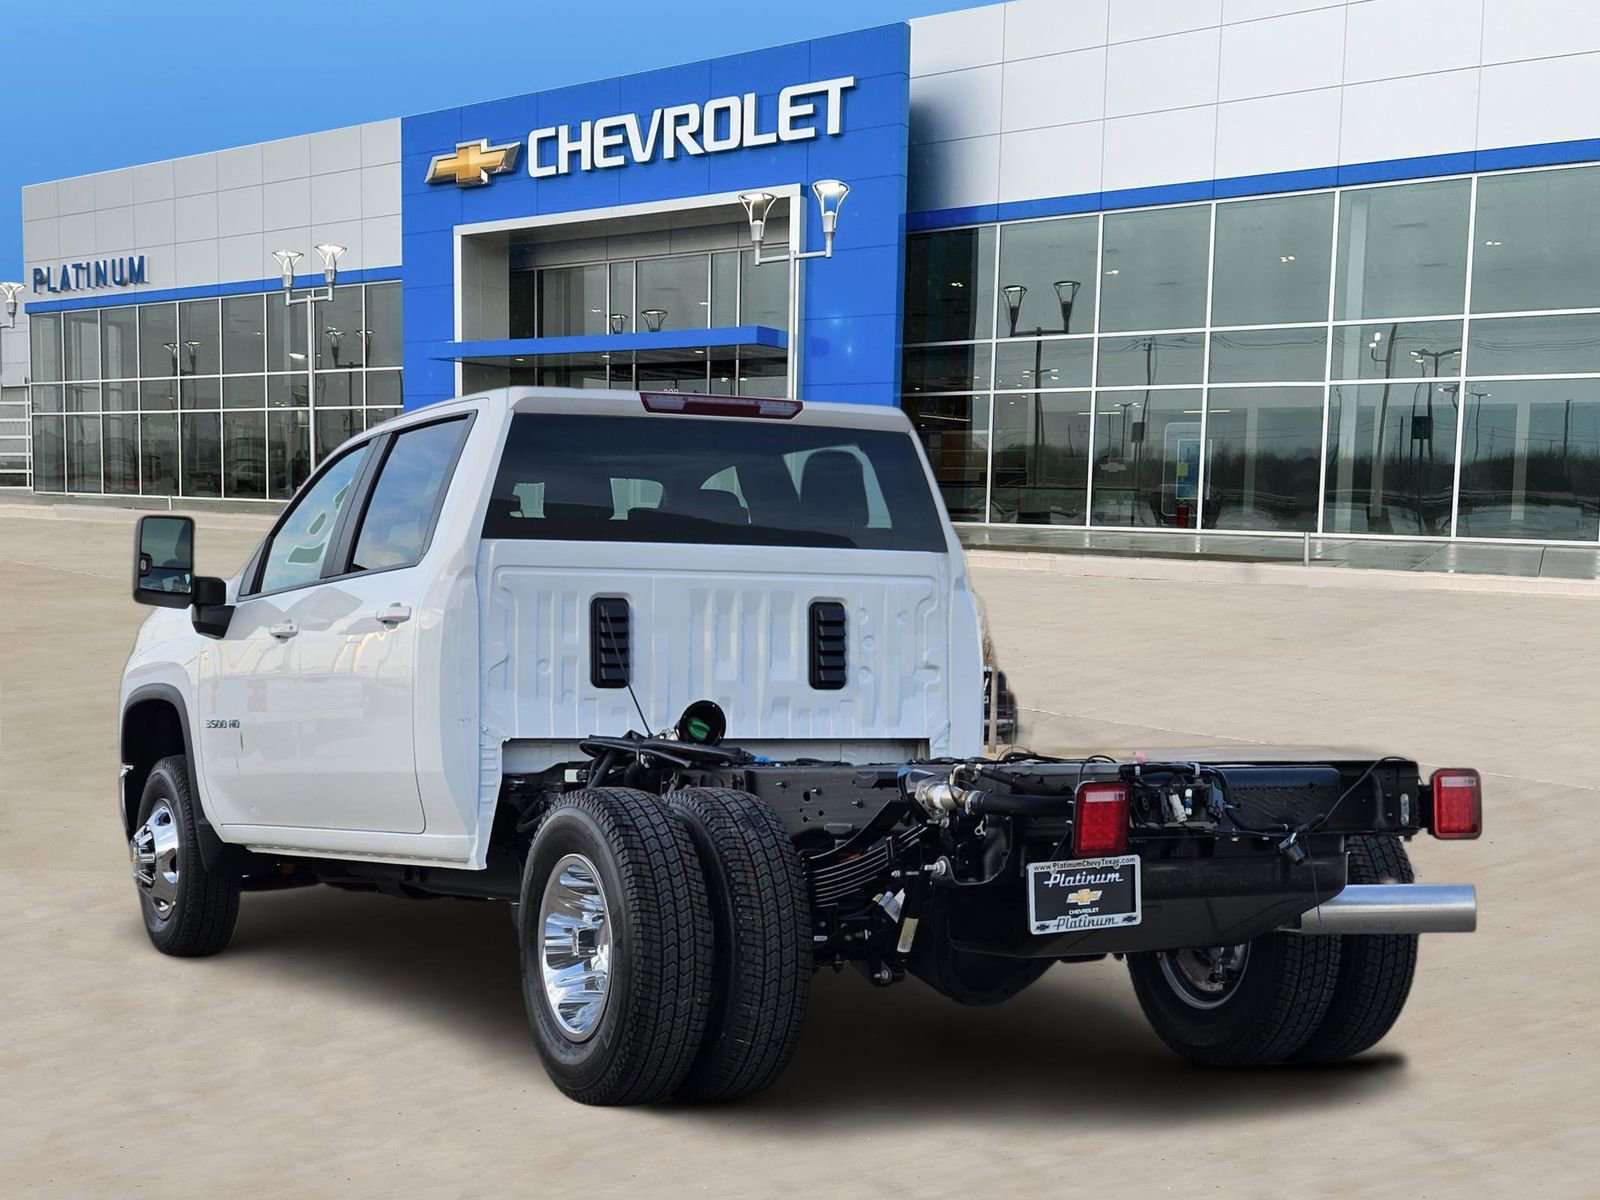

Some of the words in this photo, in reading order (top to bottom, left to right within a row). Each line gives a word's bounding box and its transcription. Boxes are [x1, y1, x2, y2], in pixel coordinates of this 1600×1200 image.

[527, 75, 856, 178] CHEVROLET
[33, 255, 145, 293] PLATINUM
[206, 719, 227, 729] 3500
[228, 719, 240, 729] HD
[1034, 858, 1136, 871] wwwPlatinumChevyTexas.com
[1043, 870, 1124, 888] Platinum
[1068, 907, 1100, 915] CHEVROLET
[1053, 914, 1119, 930] Platinum
